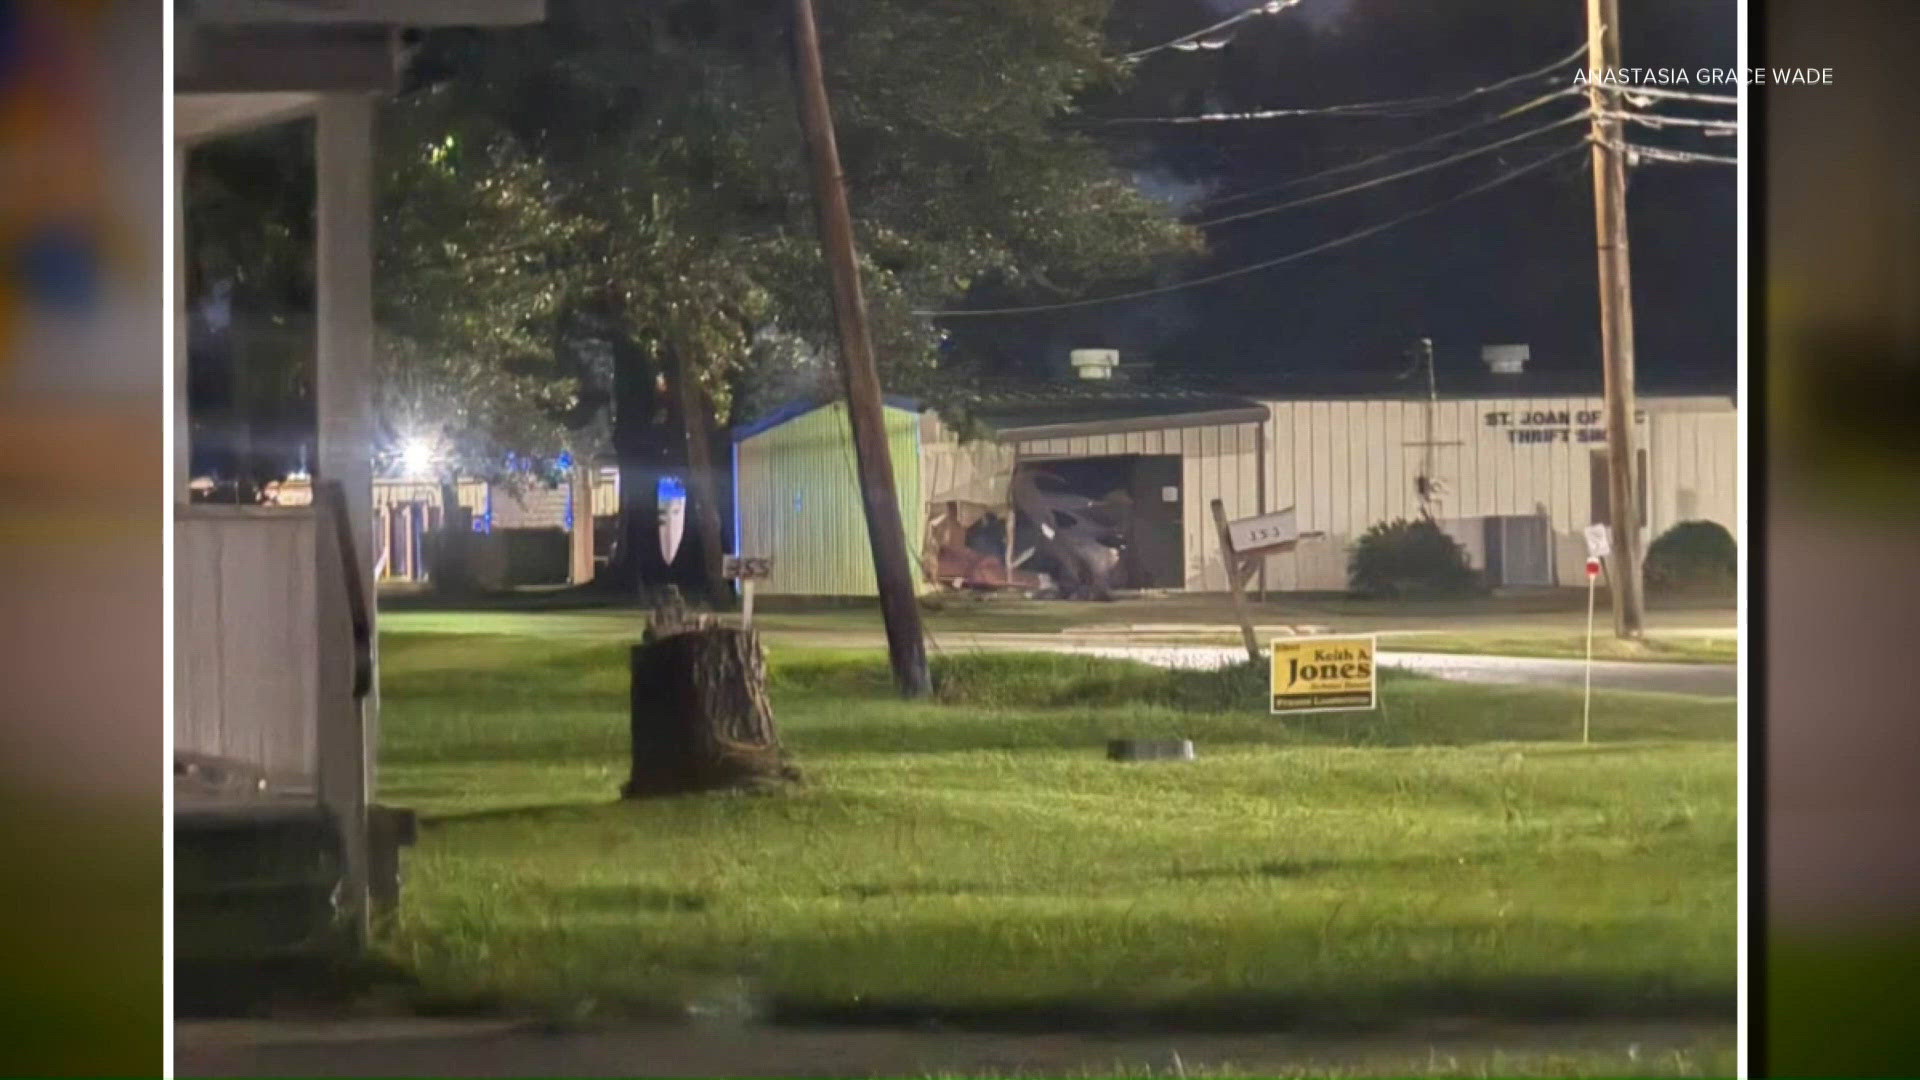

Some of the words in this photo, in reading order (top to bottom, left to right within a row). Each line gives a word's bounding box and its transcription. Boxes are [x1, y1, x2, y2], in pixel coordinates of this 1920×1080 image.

[1520, 410, 1570, 426] JOAN
[1576, 410, 1602, 425] OF
[1508, 429, 1570, 443] THRIFT
[1314, 648, 1354, 662] Keith
[1288, 658, 1371, 688] Jones
